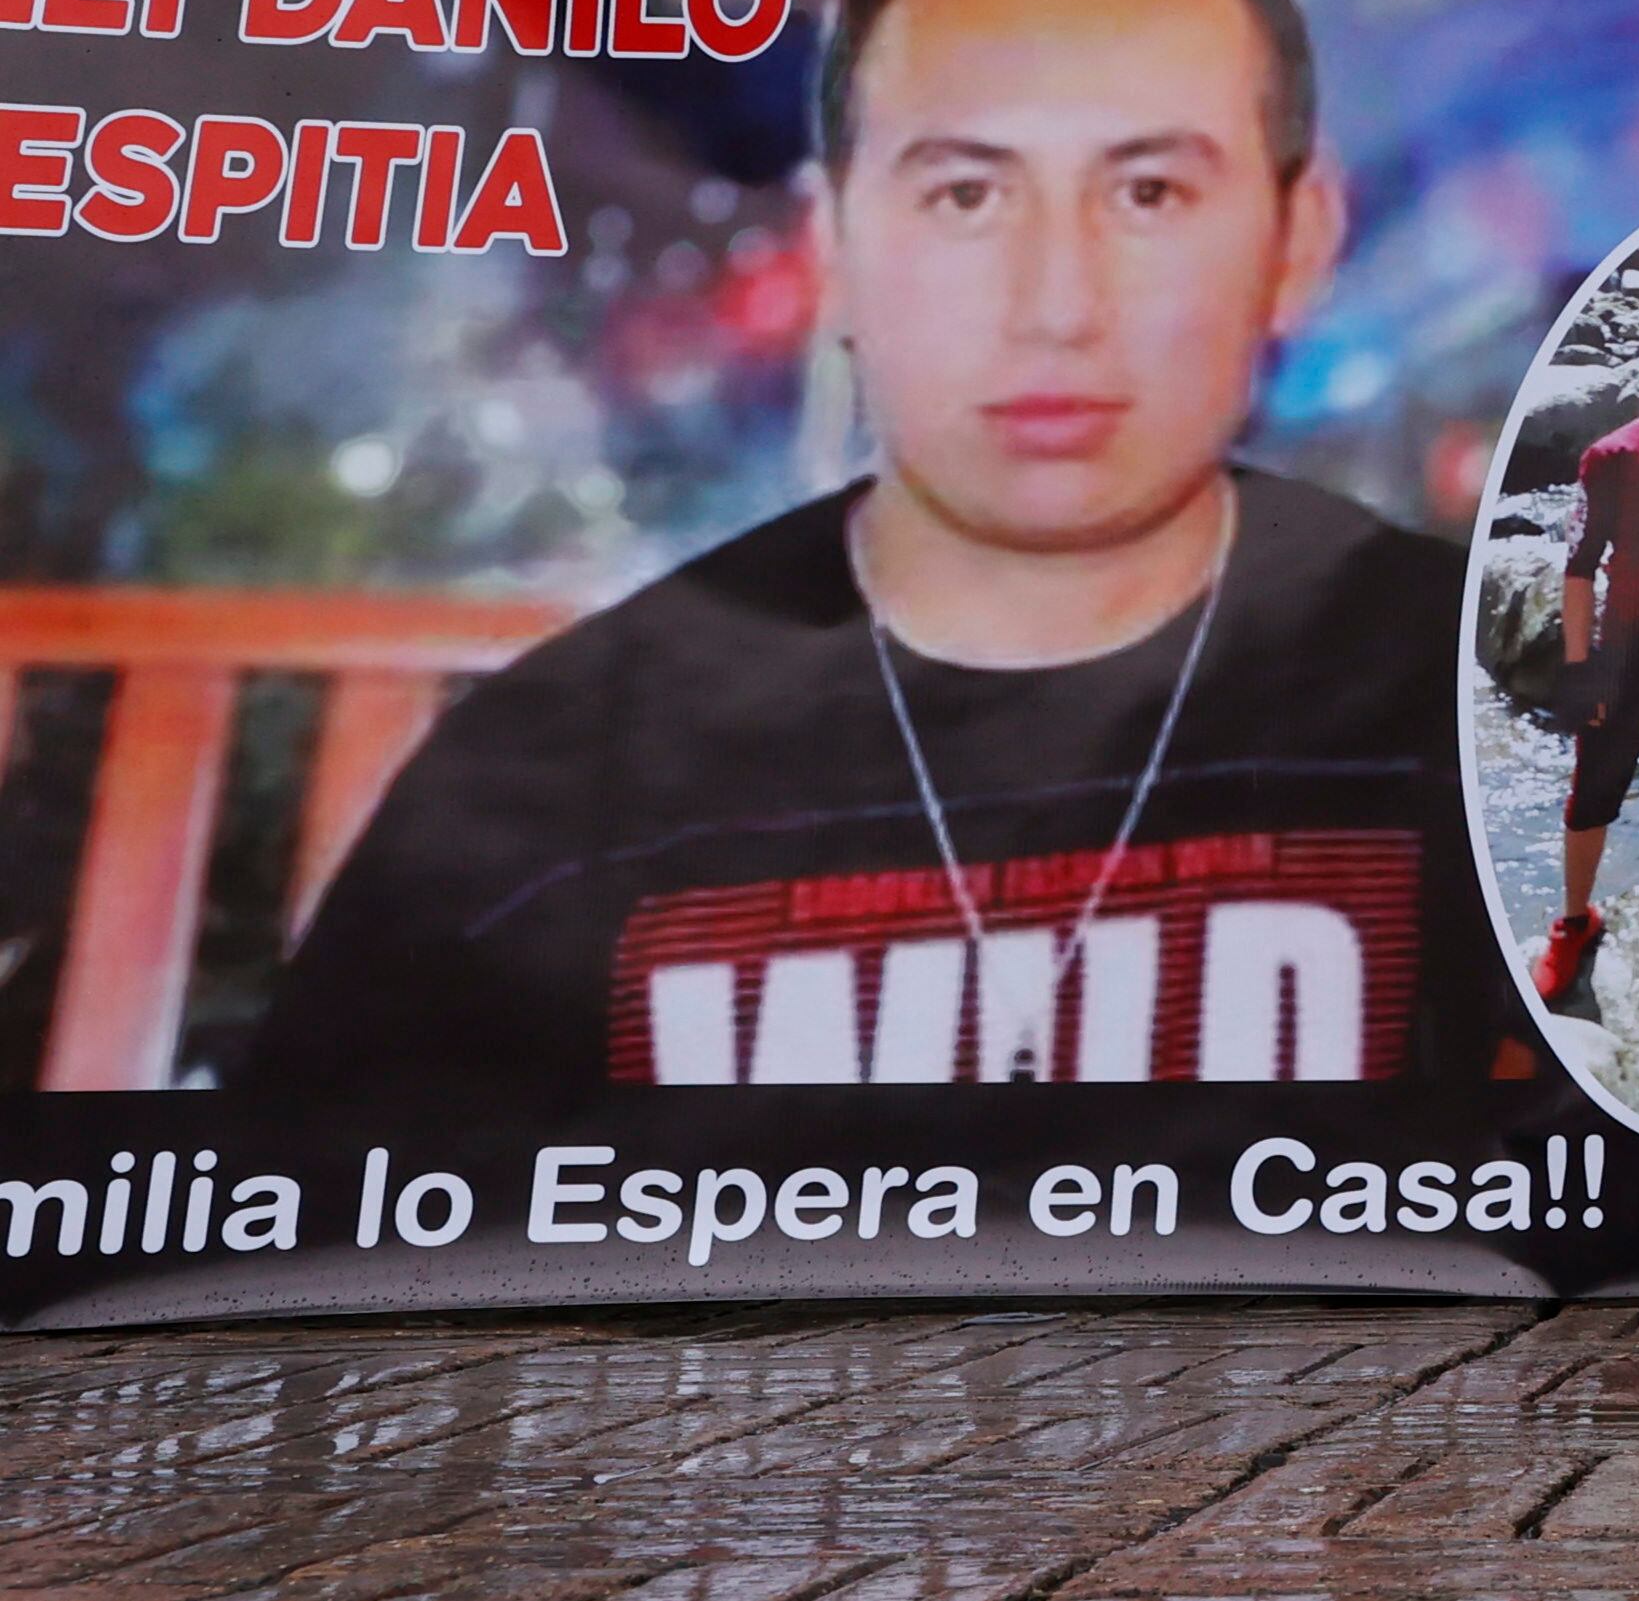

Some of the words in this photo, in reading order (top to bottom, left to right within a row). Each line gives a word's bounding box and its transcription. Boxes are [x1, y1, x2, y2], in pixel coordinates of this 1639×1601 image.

[0, 103, 568, 257] ESPITIA
[356, 1146, 474, 1248] lo
[527, 1145, 979, 1267] Espera
[1029, 1162, 1179, 1239] en
[1231, 1135, 1605, 1236] Casa!!
